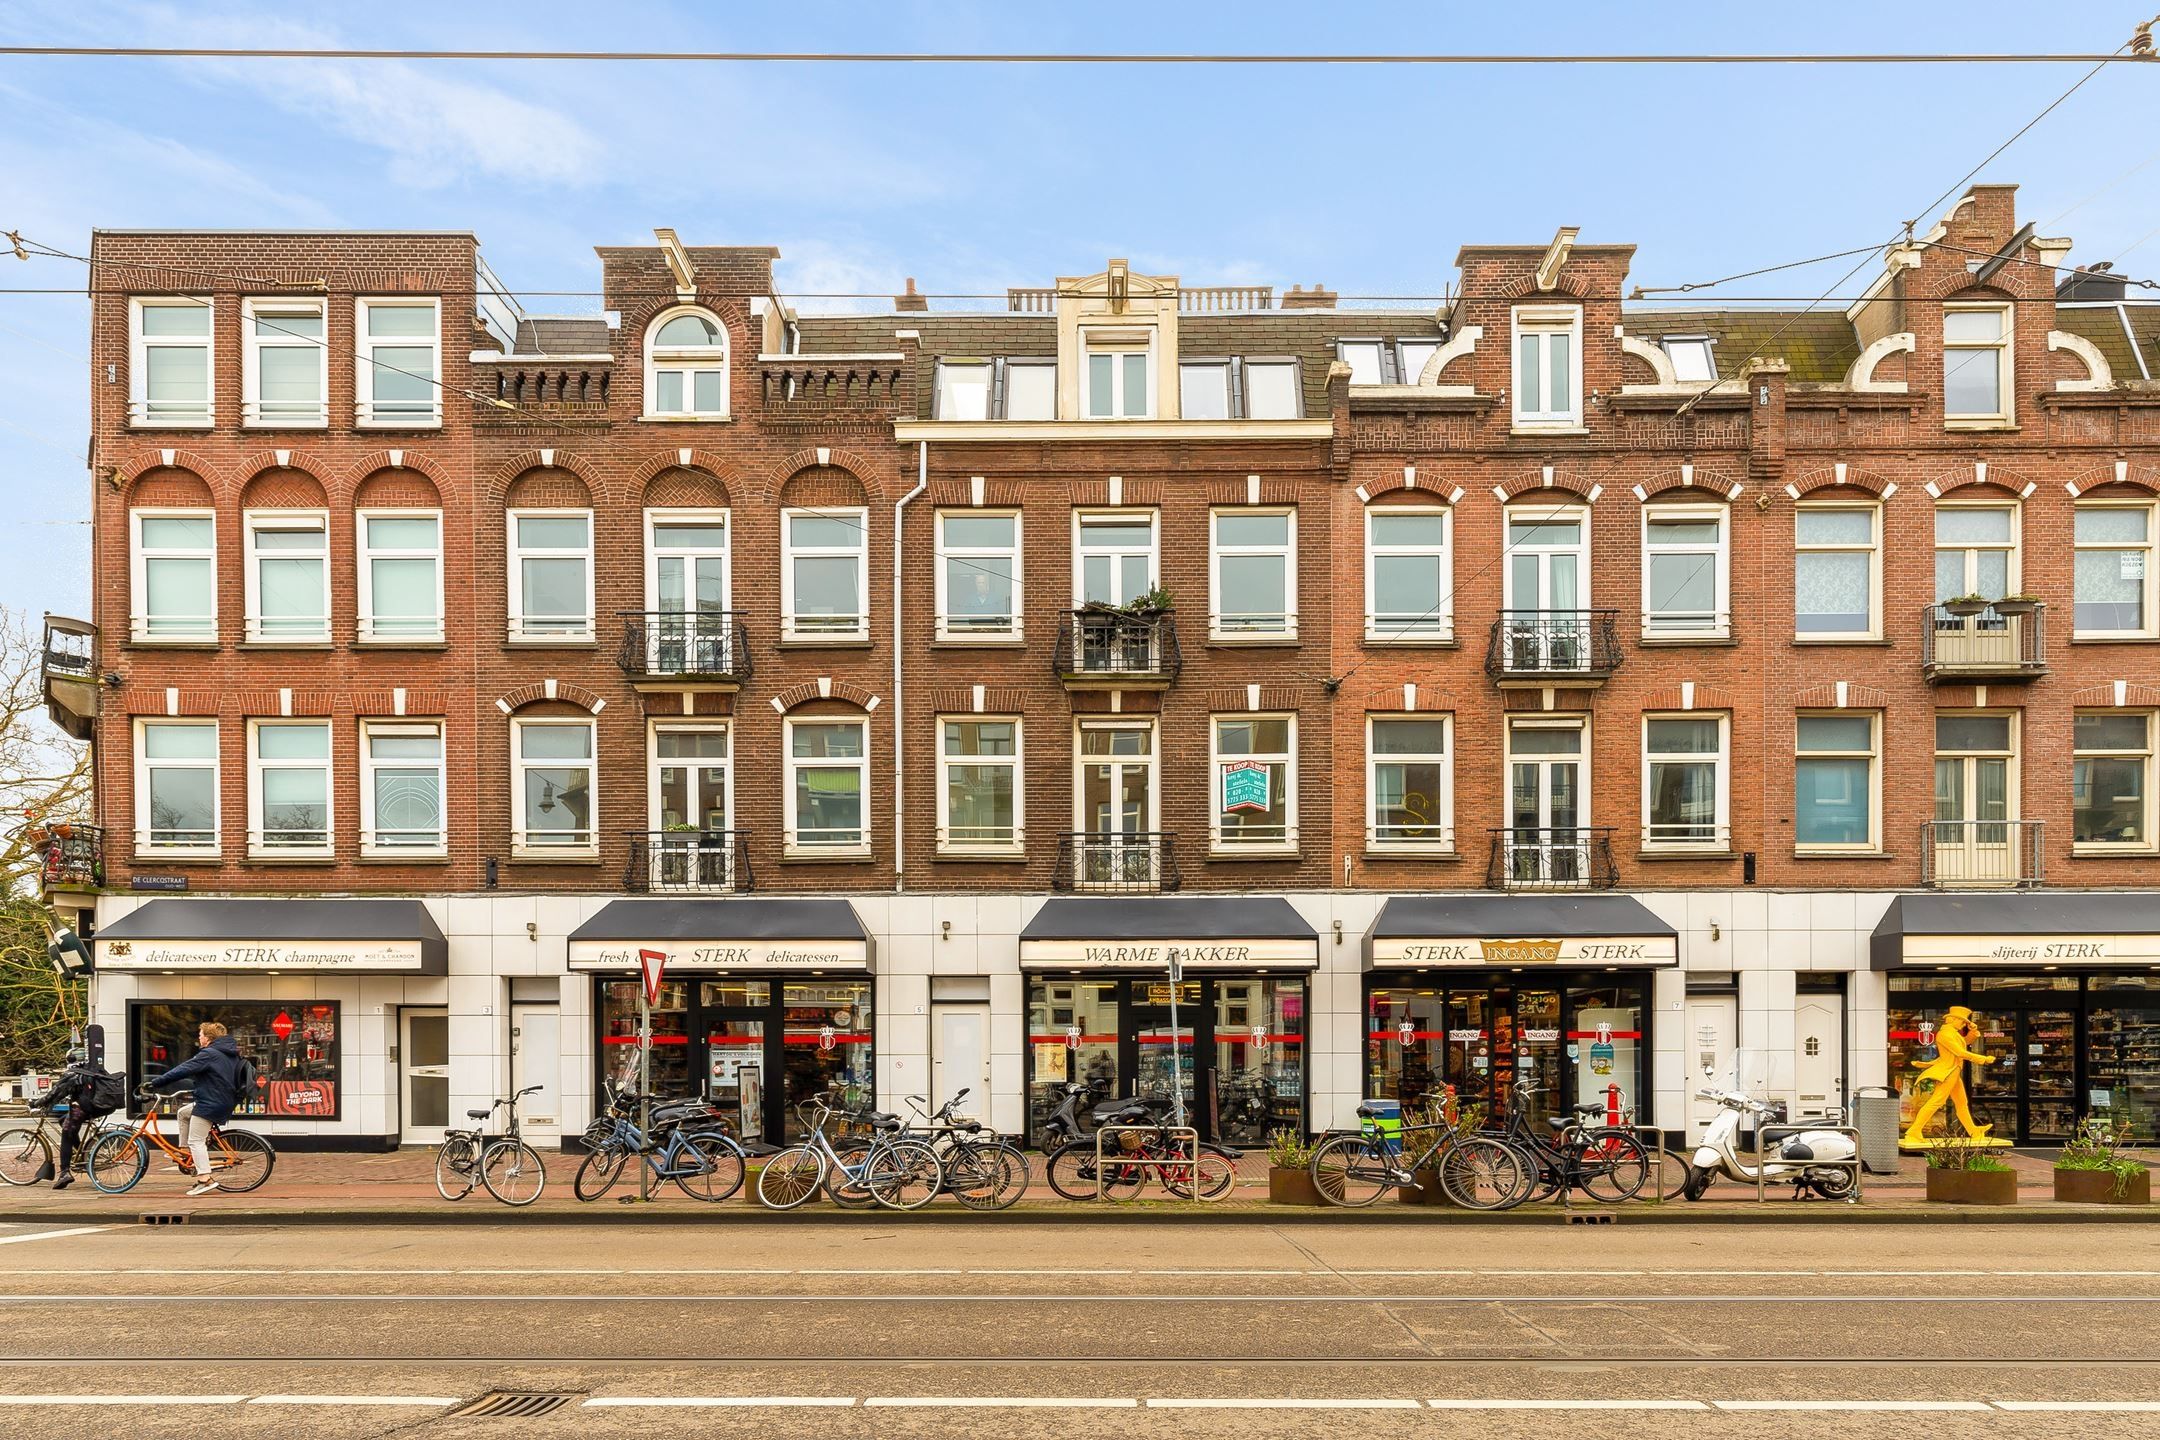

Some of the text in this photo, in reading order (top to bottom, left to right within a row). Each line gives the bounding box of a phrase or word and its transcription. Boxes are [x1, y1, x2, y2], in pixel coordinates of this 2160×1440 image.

[1233, 761, 1248, 770] KOOP
[145, 950, 217, 962] delicatessen
[223, 948, 281, 963] STERK
[285, 950, 356, 965] champagne
[598, 950, 676, 963] fresh cer
[691, 948, 839, 963] STERK delicatessen
[1085, 947, 1159, 962] WARME
[1402, 945, 1470, 960] STERK
[1486, 946, 1557, 961] INGANG
[1578, 944, 1646, 959] STERK
[1991, 943, 2104, 960] slijterij STERK
[1449, 1030, 1478, 1038] INGANG
[1527, 1030, 1557, 1038] INGANG
[289, 1090, 321, 1099] BEYOND
[302, 1096, 323, 1104] DARK
